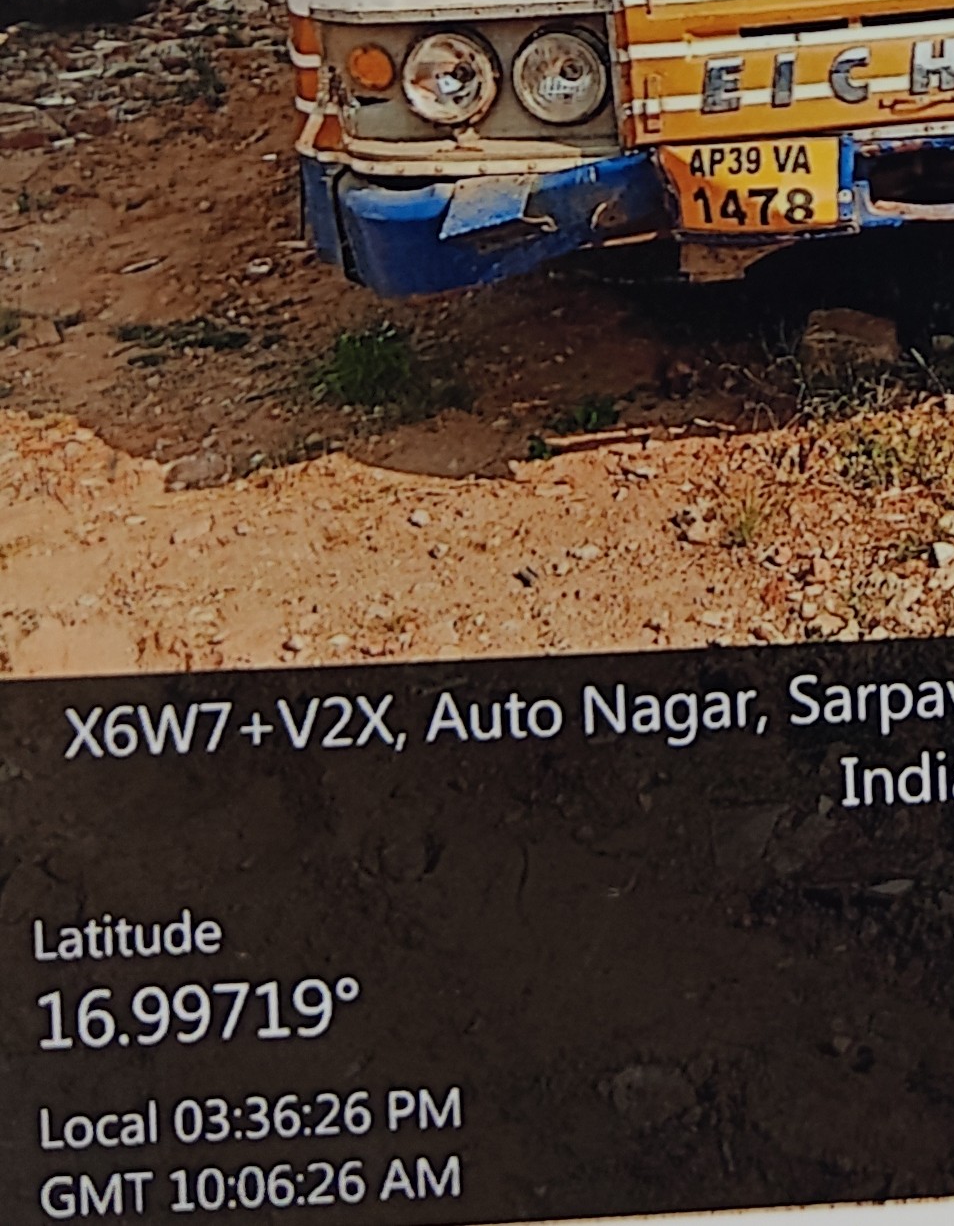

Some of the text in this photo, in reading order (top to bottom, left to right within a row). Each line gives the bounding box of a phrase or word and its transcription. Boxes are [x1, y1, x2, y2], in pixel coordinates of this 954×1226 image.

[688, 143, 812, 179] AP39 VA
[691, 186, 815, 227] 1478
